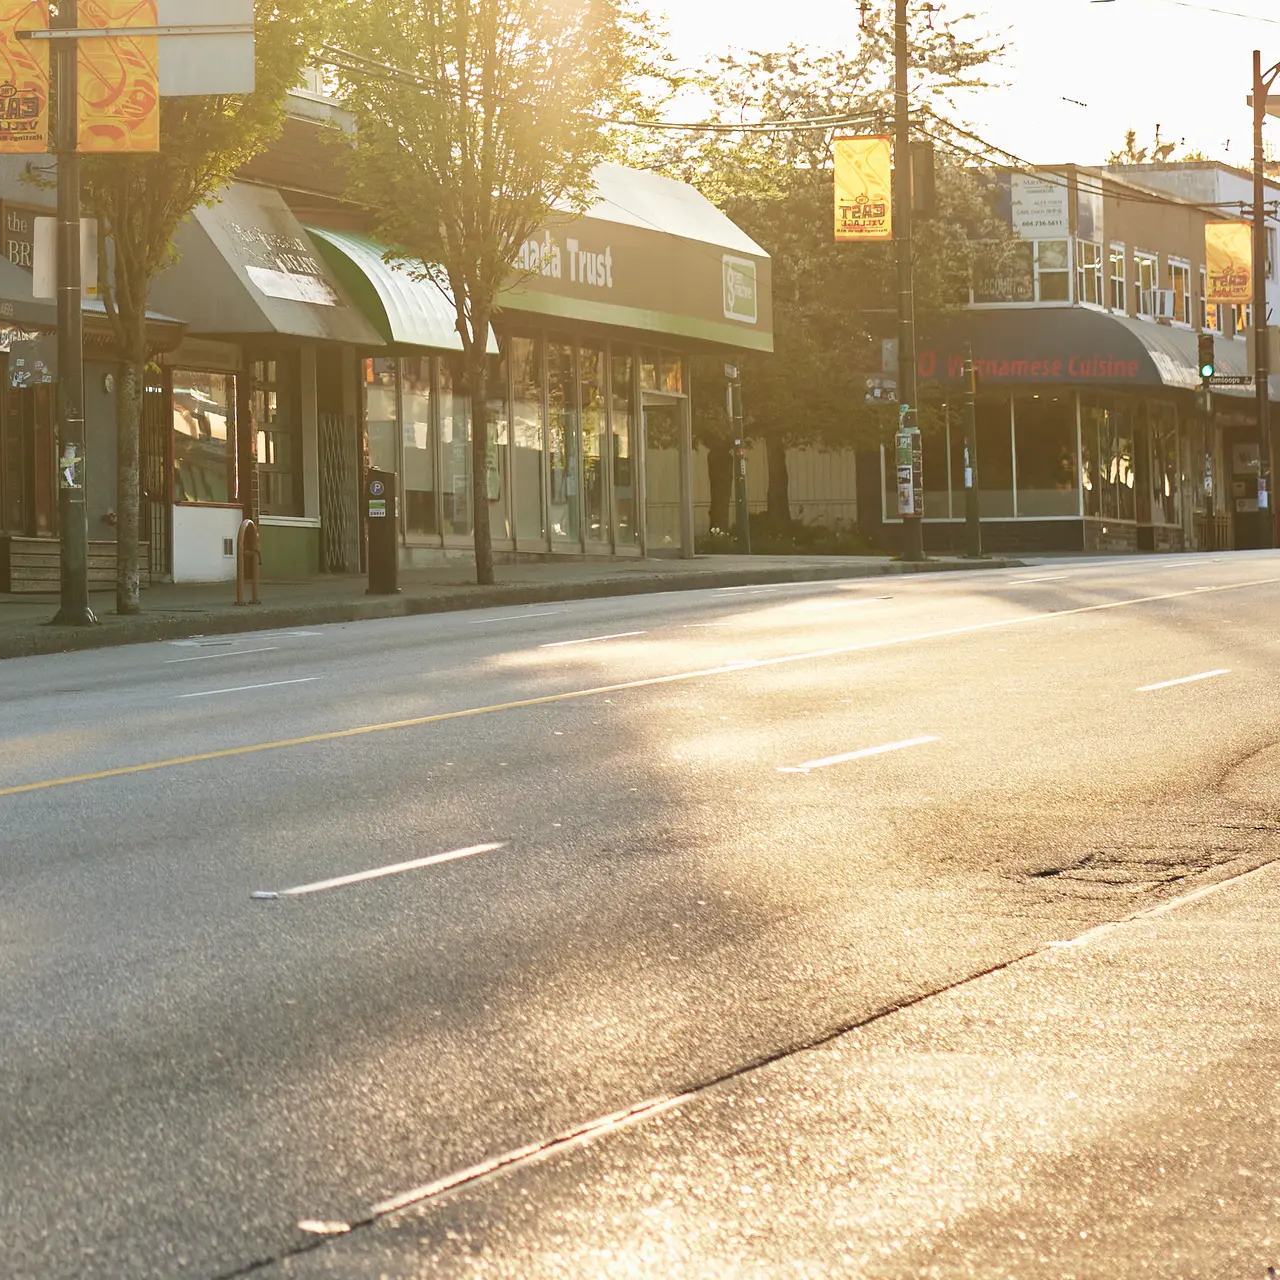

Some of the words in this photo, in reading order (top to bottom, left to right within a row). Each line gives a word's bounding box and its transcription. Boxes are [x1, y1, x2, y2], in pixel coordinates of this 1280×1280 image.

[7, 211, 28, 233] the
[566, 237, 613, 288] Trust
[1068, 353, 1140, 379] Cuisine
